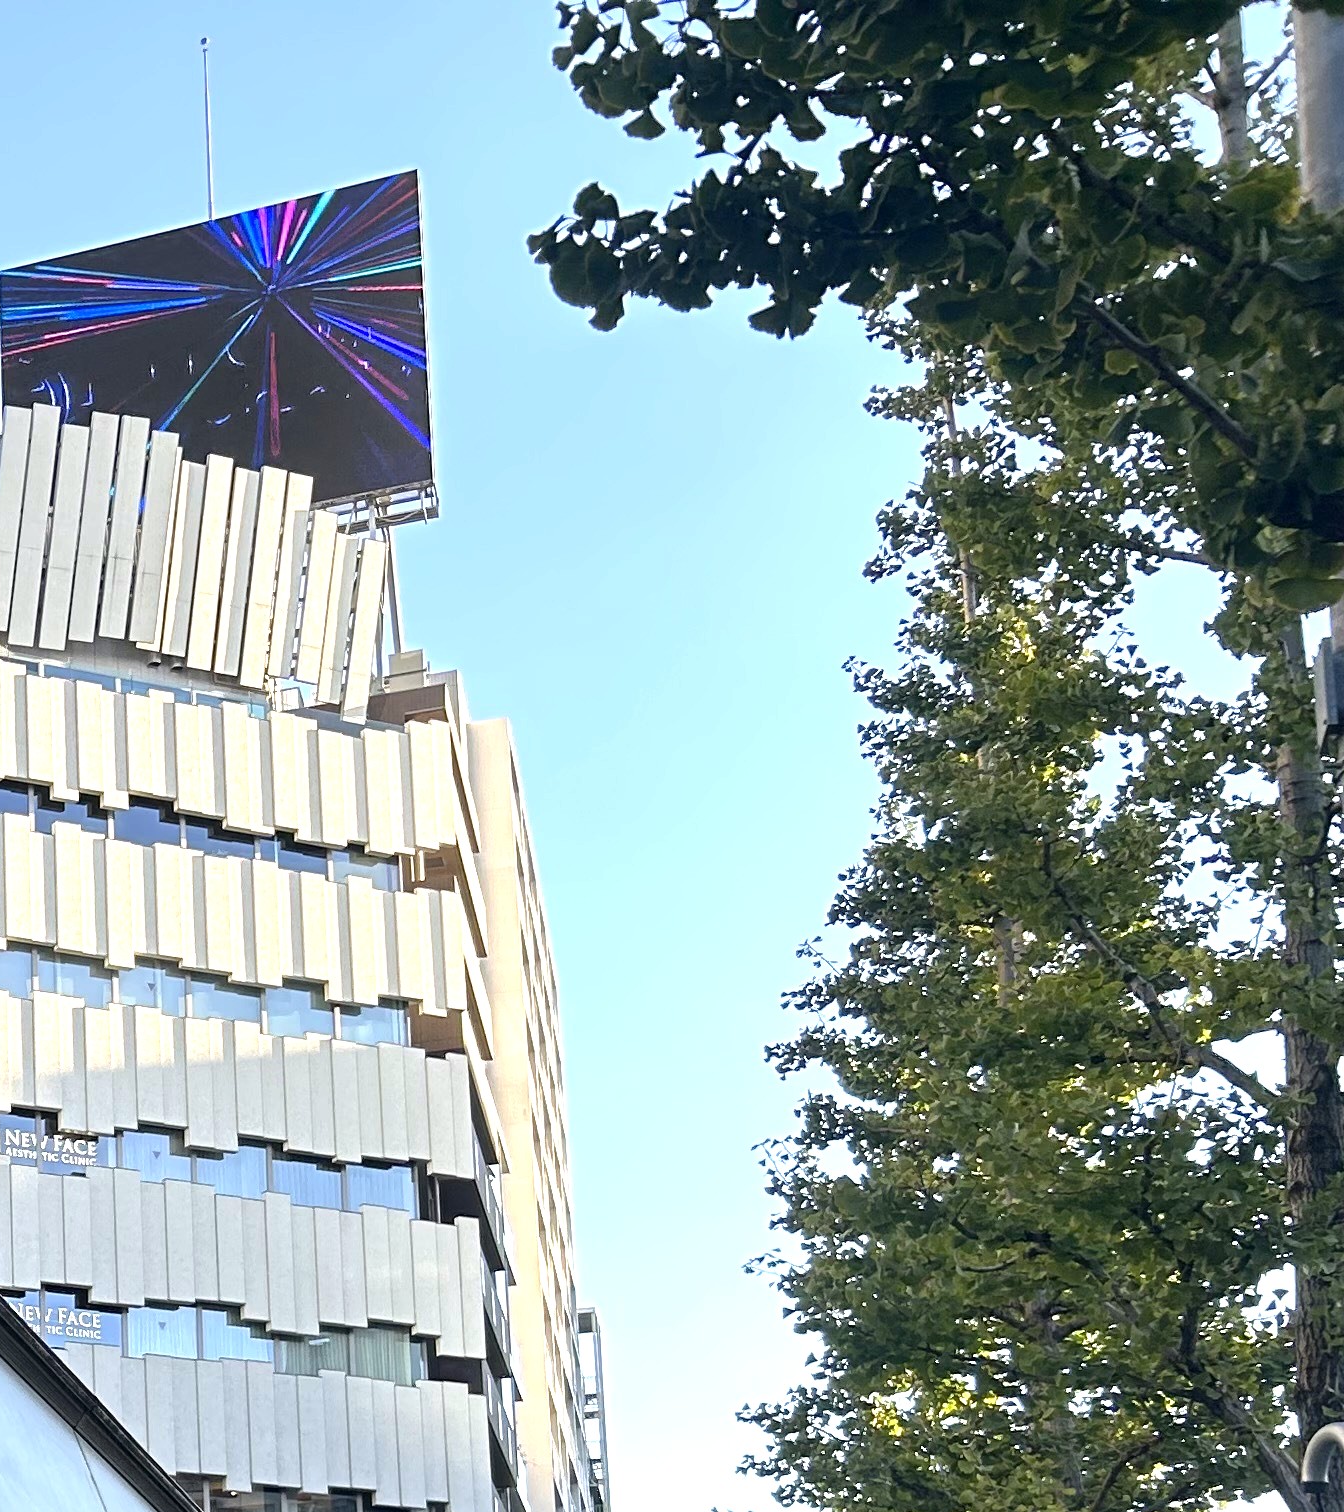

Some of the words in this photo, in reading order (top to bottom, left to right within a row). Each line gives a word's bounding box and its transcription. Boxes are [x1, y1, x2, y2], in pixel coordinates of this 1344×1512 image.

[4, 1128, 47, 1149] NEW
[52, 1134, 98, 1157] FACE
[5, 1147, 60, 1163] AESTHTIC
[61, 1154, 97, 1167] CLINIC
[58, 1307, 102, 1328] FACE
[65, 1326, 102, 1340] CLINIC
